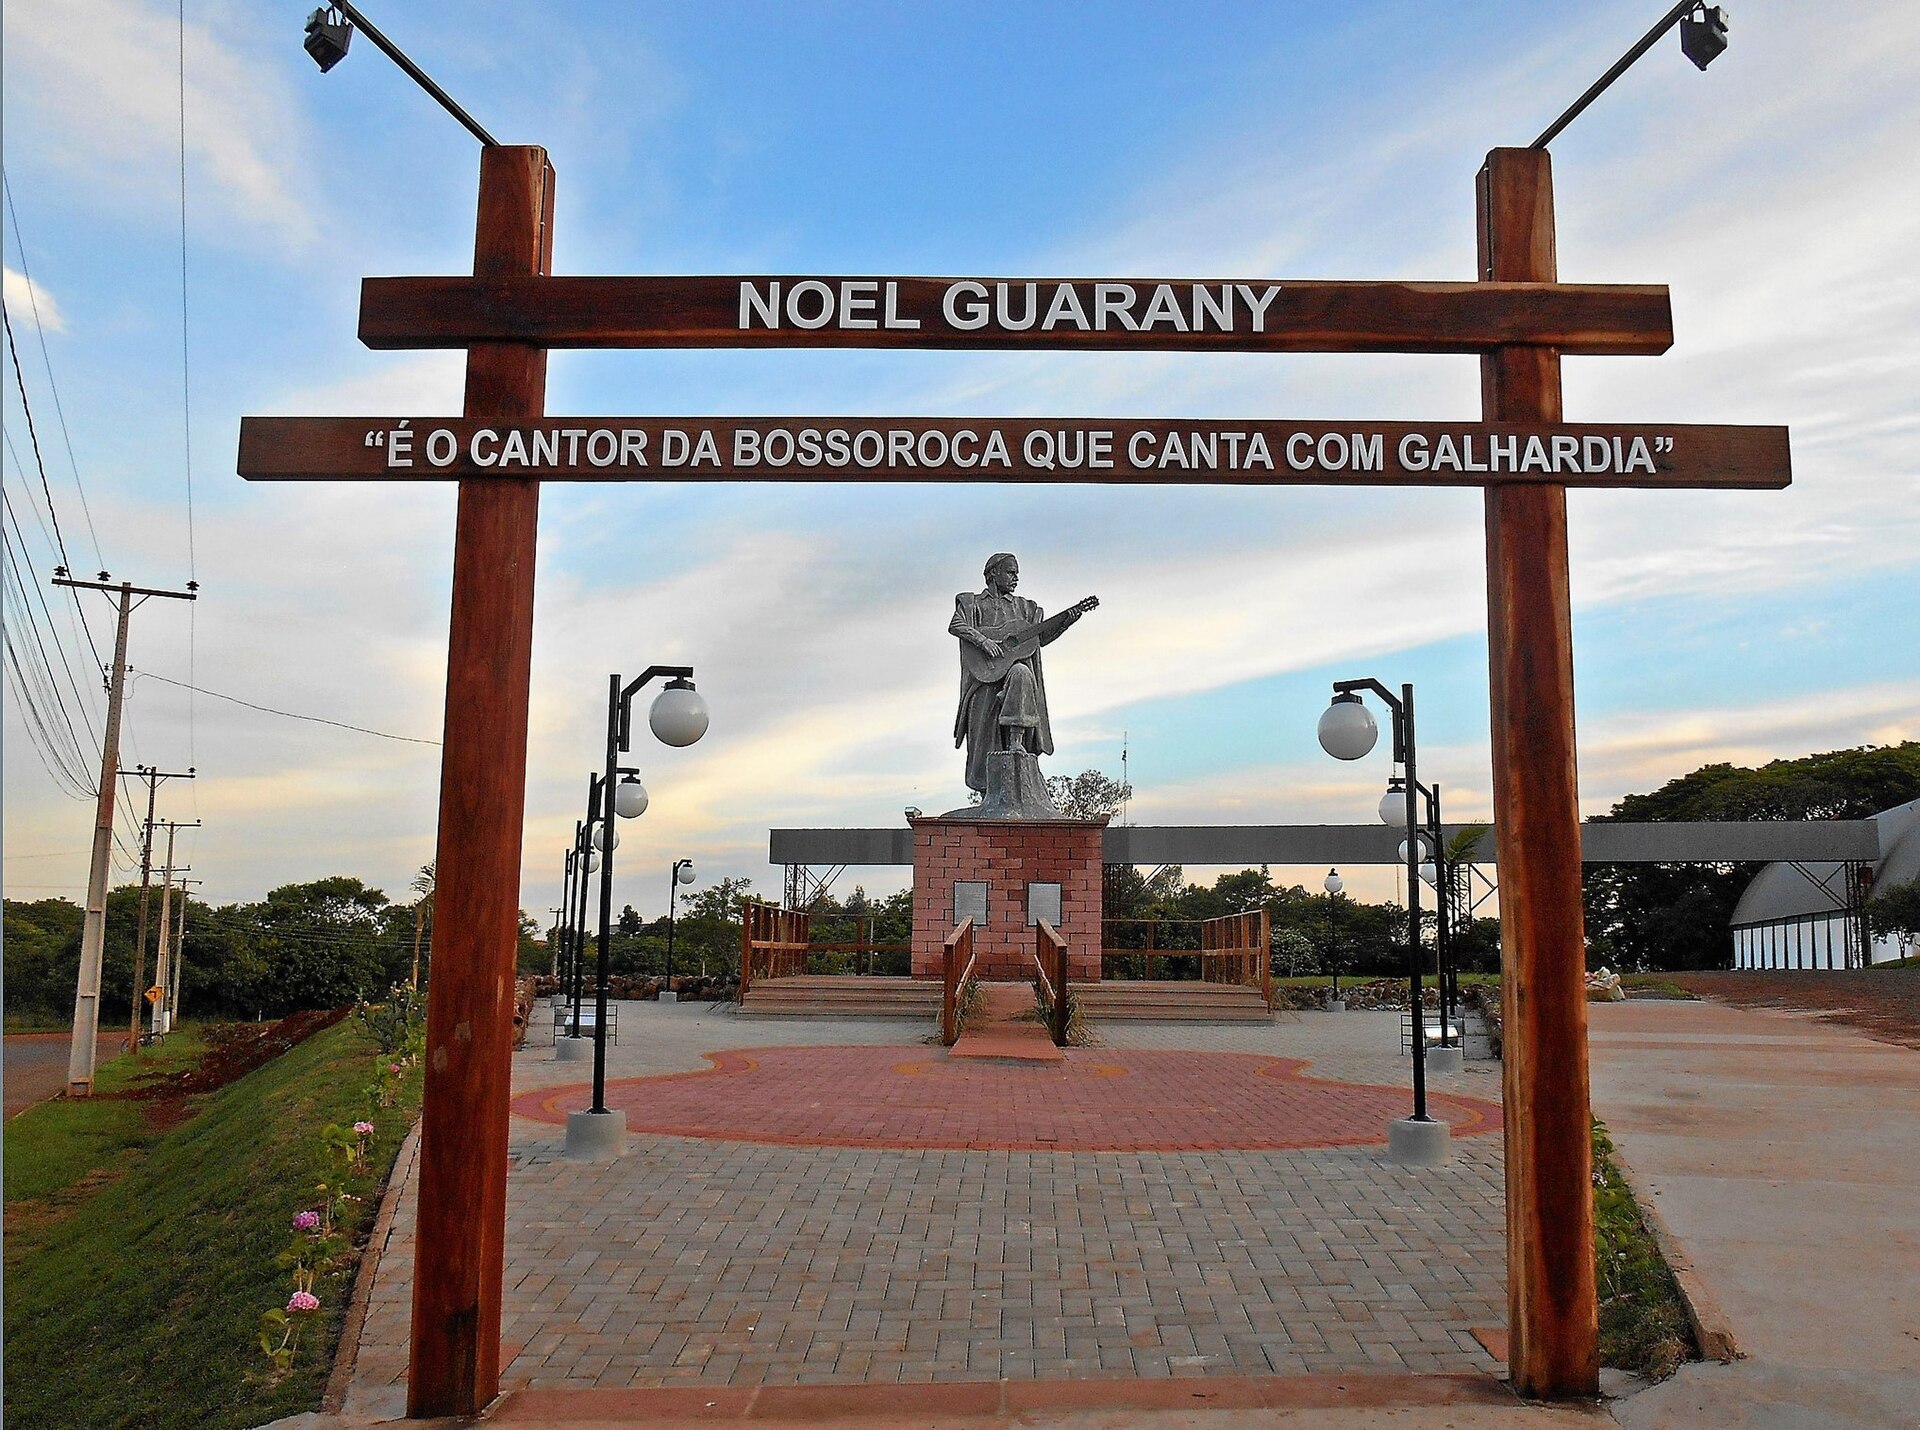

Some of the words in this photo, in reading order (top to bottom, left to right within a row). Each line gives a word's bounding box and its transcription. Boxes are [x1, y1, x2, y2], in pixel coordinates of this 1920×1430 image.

[737, 280, 921, 331] NOEL
[942, 280, 1282, 333] GUARANY
[426, 428, 458, 468] O
[470, 428, 649, 468] CANTOR
[661, 428, 722, 468] DA
[733, 428, 1012, 468] BOSSOROCA
[1023, 429, 1114, 471] QUE
[1128, 430, 1275, 470] CANTA
[1286, 431, 1384, 471] COM
[1398, 433, 1674, 475] GALHARDIA”
